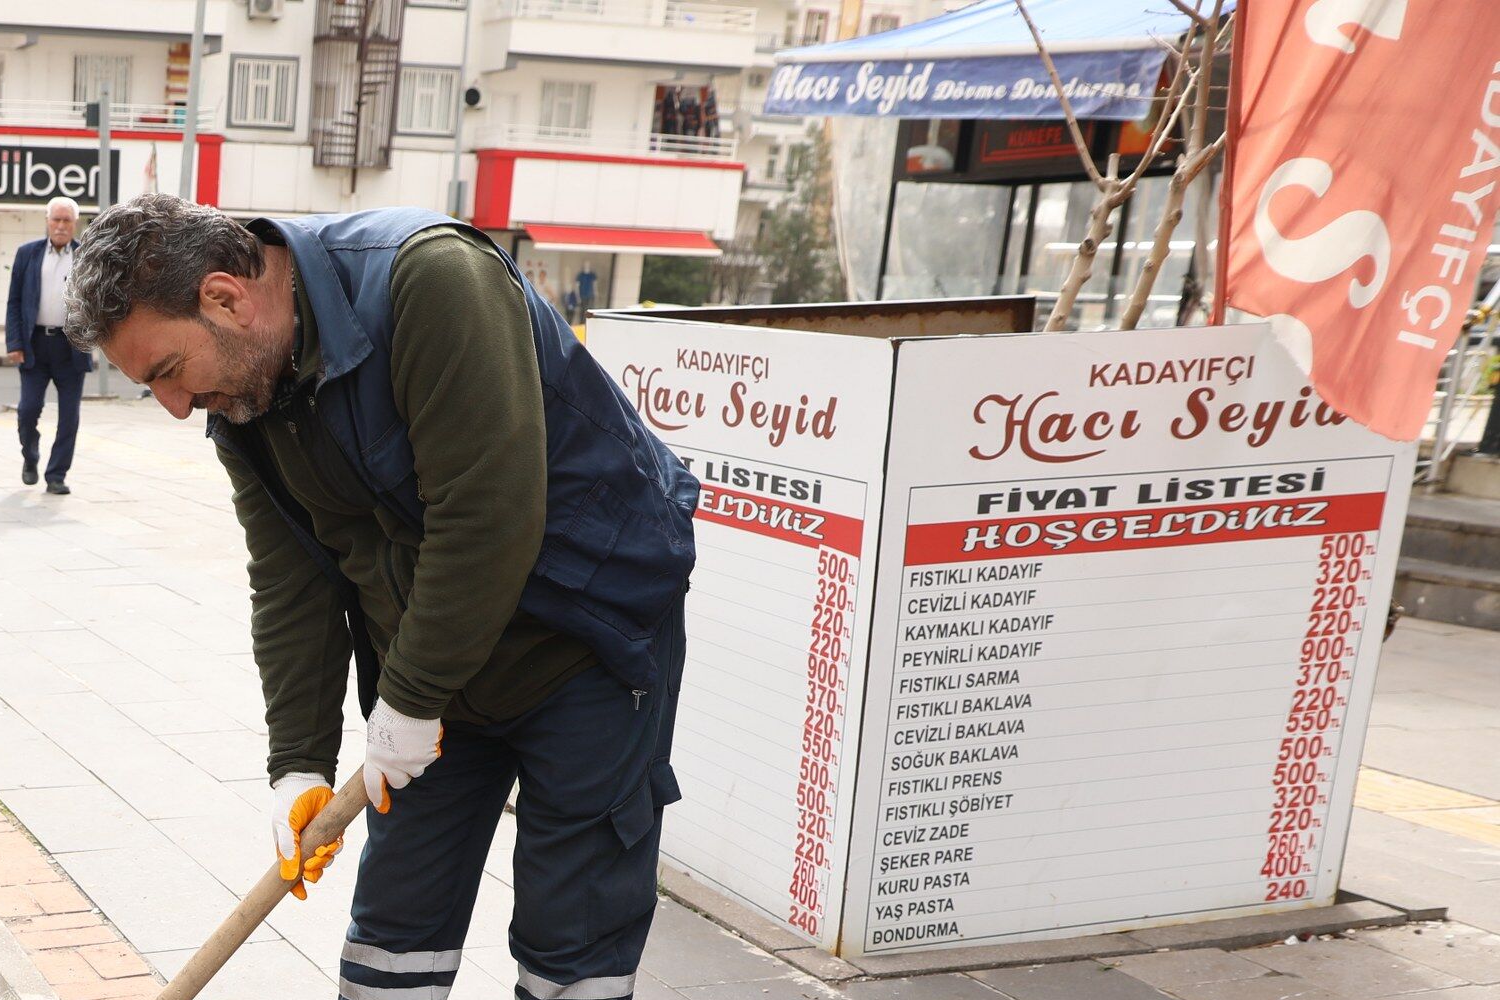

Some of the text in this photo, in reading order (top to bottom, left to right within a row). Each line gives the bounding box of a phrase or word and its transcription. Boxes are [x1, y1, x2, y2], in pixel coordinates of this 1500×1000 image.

[771, 64, 840, 102] Hacı
[845, 61, 936, 115] Seyid
[677, 348, 770, 383] KADAYIFÇI
[1089, 355, 1256, 388] KADAYIFÇI
[622, 364, 838, 448] Hacı Seyid
[968, 390, 1142, 463] Hacı
[705, 460, 823, 504] LİSTESİ
[976, 467, 1326, 515] FİYAT LİSTESİ
[910, 562, 1043, 588] FISTIKLI KADAYIF
[907, 589, 1037, 614] CEVİZLİ KADAYIF
[904, 614, 1054, 641] KAYMAKLI KADAYIF
[902, 641, 1043, 668] PEYNİRLİ KADAYIF
[899, 669, 1020, 694] FISTIKLI SARMA
[896, 693, 1032, 720] FISTIKLI BAKLAVA
[894, 719, 1025, 746] CEVİZLİ BAKLAVA
[891, 744, 1019, 772] SOĞUK BAKLAVA
[888, 770, 1003, 797] FISTIKLI PRENS
[885, 794, 1014, 822] FISTIKLI ŞÖBİYET
[883, 823, 970, 847] CEVİZ ZADE
[880, 847, 974, 874] ŞEKER PARE
[877, 871, 970, 896] KURU PASTA
[875, 898, 955, 921] YAŞ PASTA
[872, 921, 959, 945] DONDURMA
